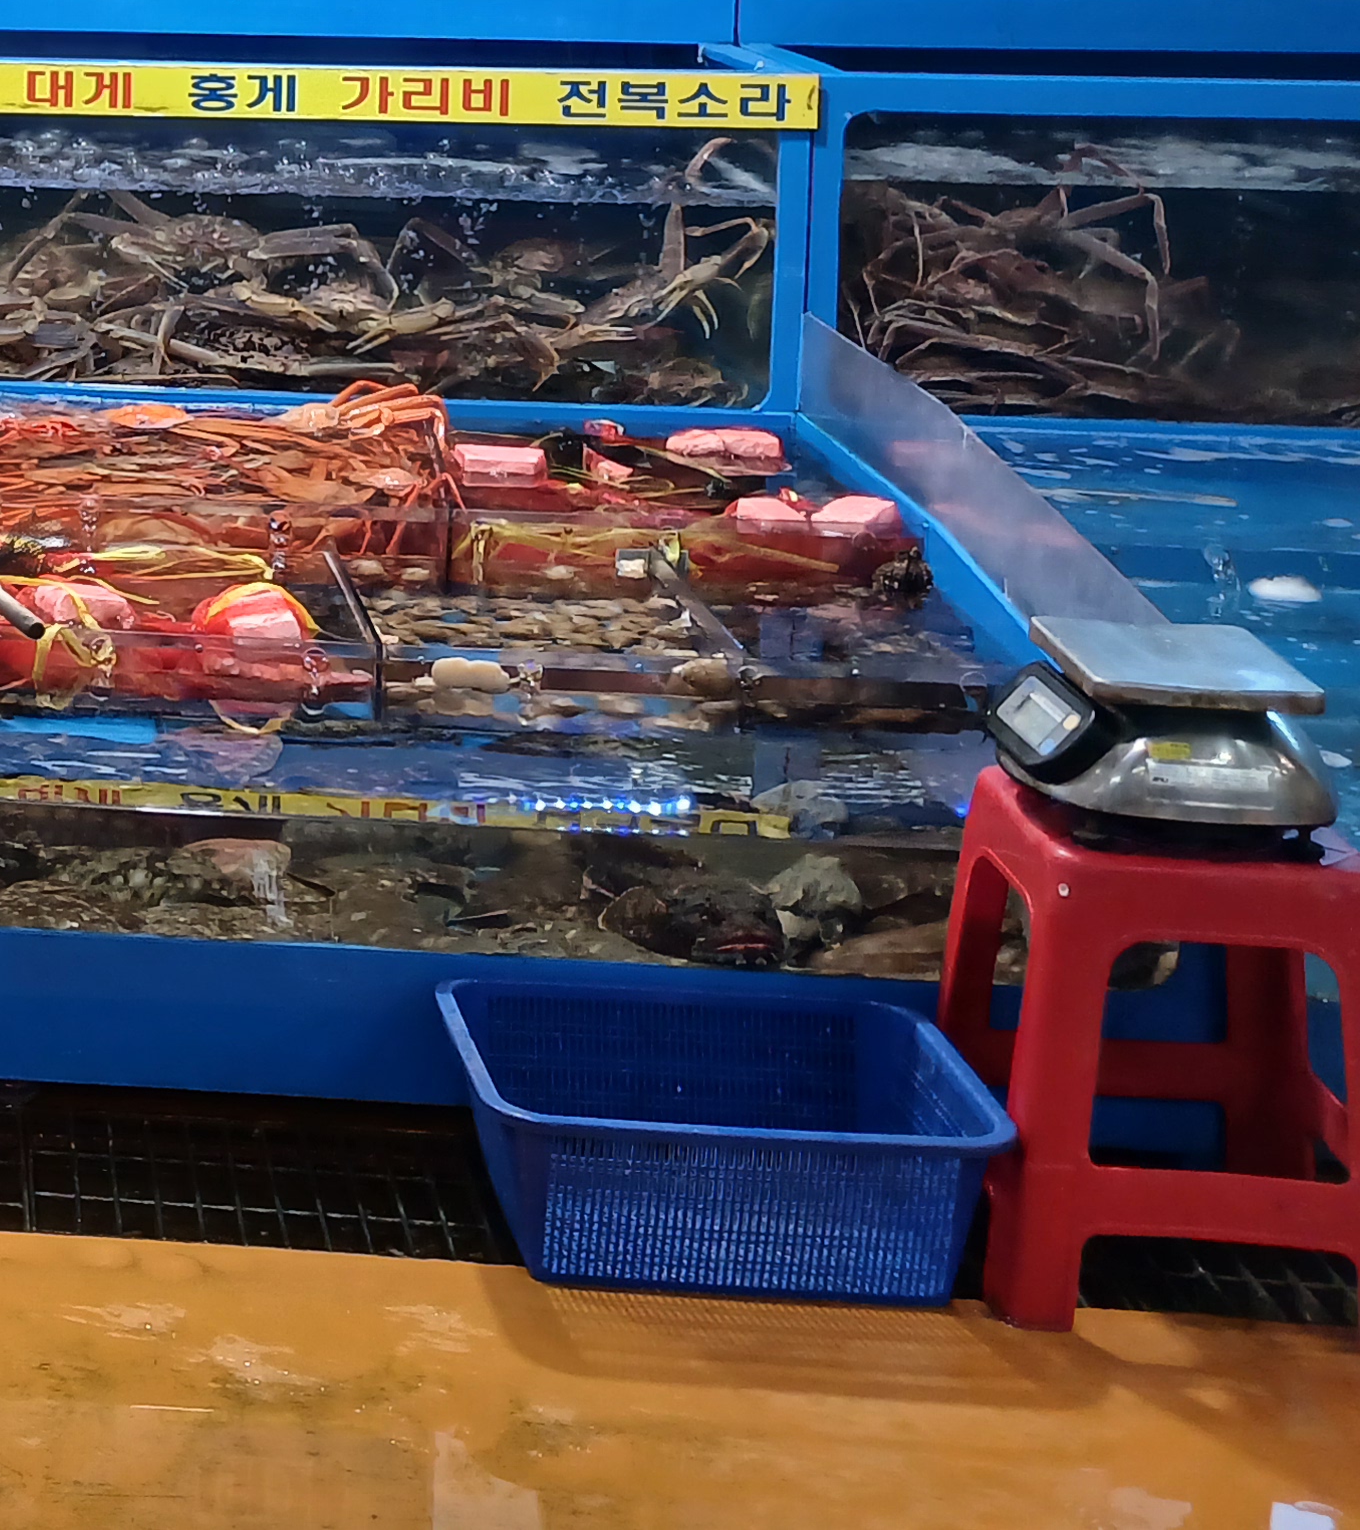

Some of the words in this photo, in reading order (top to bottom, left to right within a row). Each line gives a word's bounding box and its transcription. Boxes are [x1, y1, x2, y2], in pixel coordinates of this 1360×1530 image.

[26, 69, 134, 110] 대게
[187, 71, 299, 114] 홍게
[341, 73, 512, 118] 가리비
[556, 79, 792, 123] 전복소라
